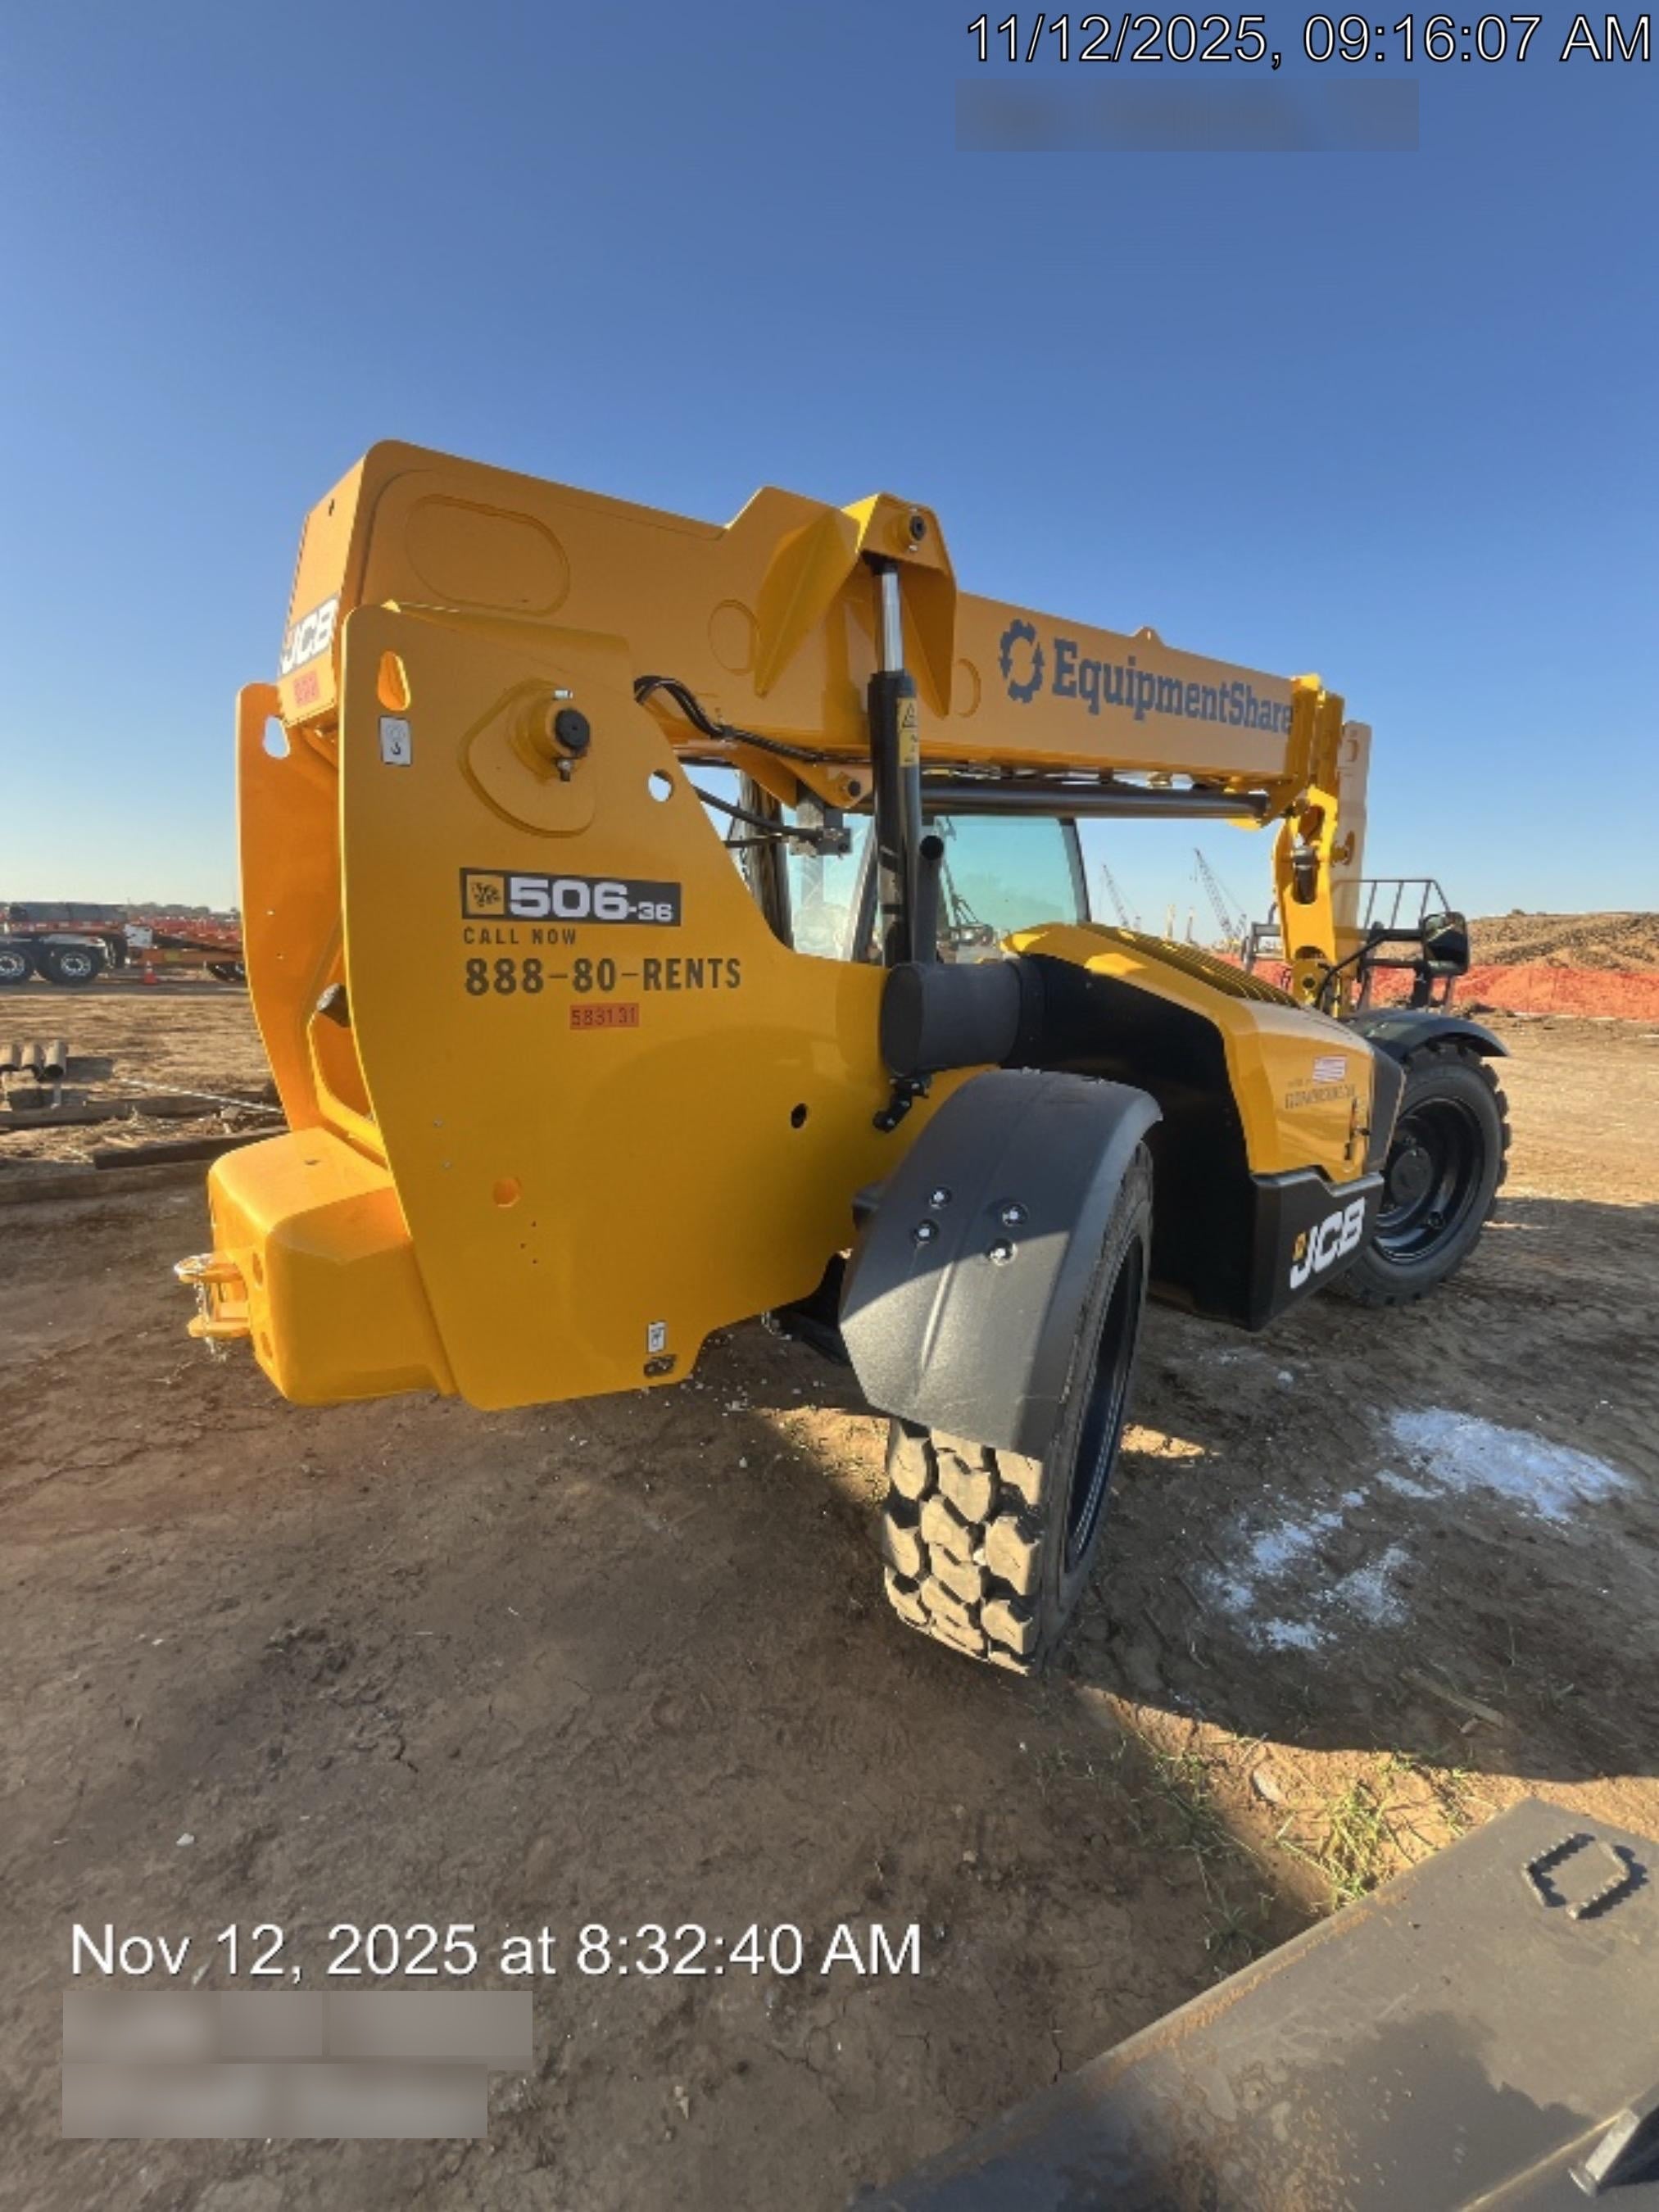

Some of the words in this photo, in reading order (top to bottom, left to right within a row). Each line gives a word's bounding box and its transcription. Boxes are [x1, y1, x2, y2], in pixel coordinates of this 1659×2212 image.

[280, 597, 338, 676] JCB
[1052, 637, 1293, 735] EquipmentShare
[463, 927, 520, 945] CALL
[533, 928, 577, 945] NOW
[465, 957, 741, 996] 888-80-RENTS
[571, 1007, 636, 1026] 583131
[1290, 1196, 1366, 1290] JCB
